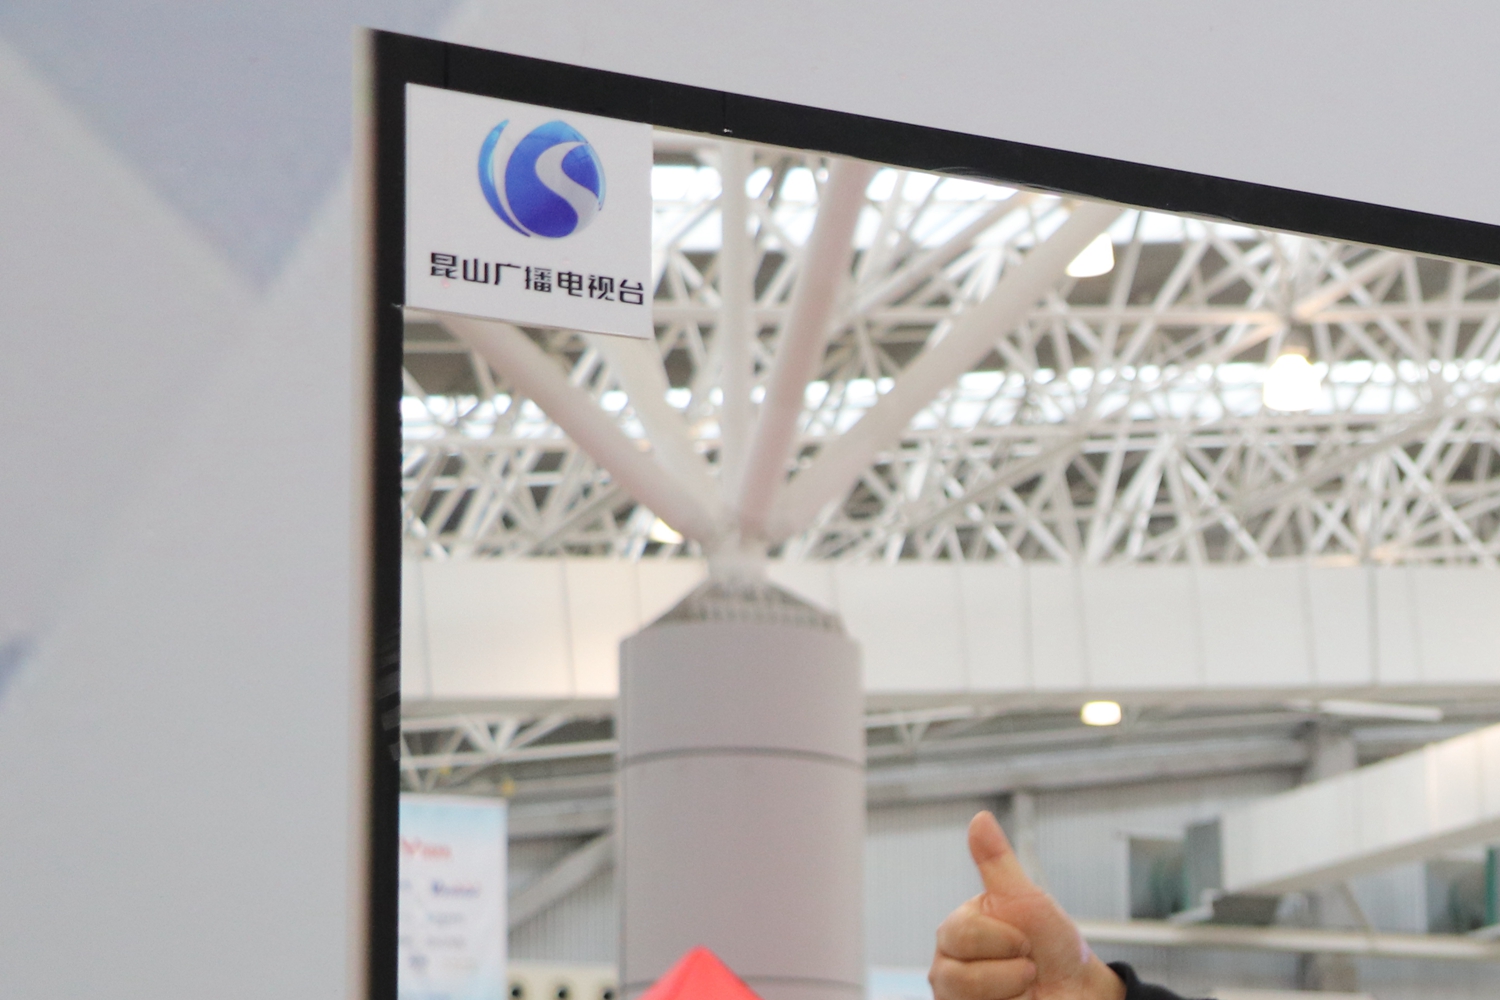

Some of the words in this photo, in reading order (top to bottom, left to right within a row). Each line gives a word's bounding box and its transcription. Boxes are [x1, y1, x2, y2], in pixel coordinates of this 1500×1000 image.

[430, 252, 644, 305] 昆山广播电视台
